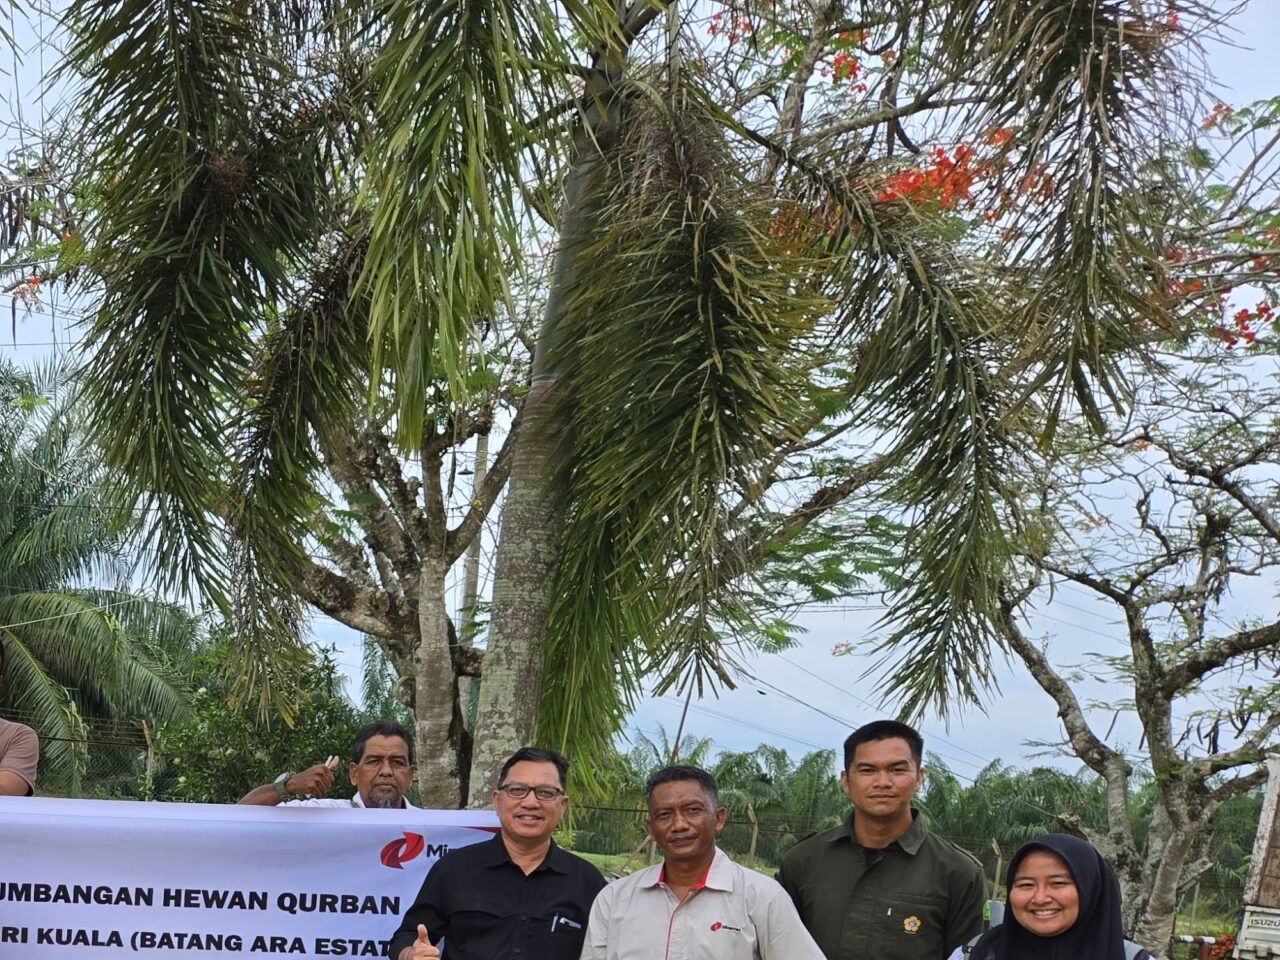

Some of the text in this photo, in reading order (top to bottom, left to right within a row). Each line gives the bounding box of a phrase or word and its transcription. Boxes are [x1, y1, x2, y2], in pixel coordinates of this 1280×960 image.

[426, 844, 449, 858] Mi
[163, 889, 267, 910] HEWAN
[278, 893, 399, 915] QURBAN
[1251, 919, 1280, 927] ISUZU
[37, 928, 123, 947] KUALA
[131, 932, 242, 951] (BATANG
[251, 936, 306, 953] ARA
